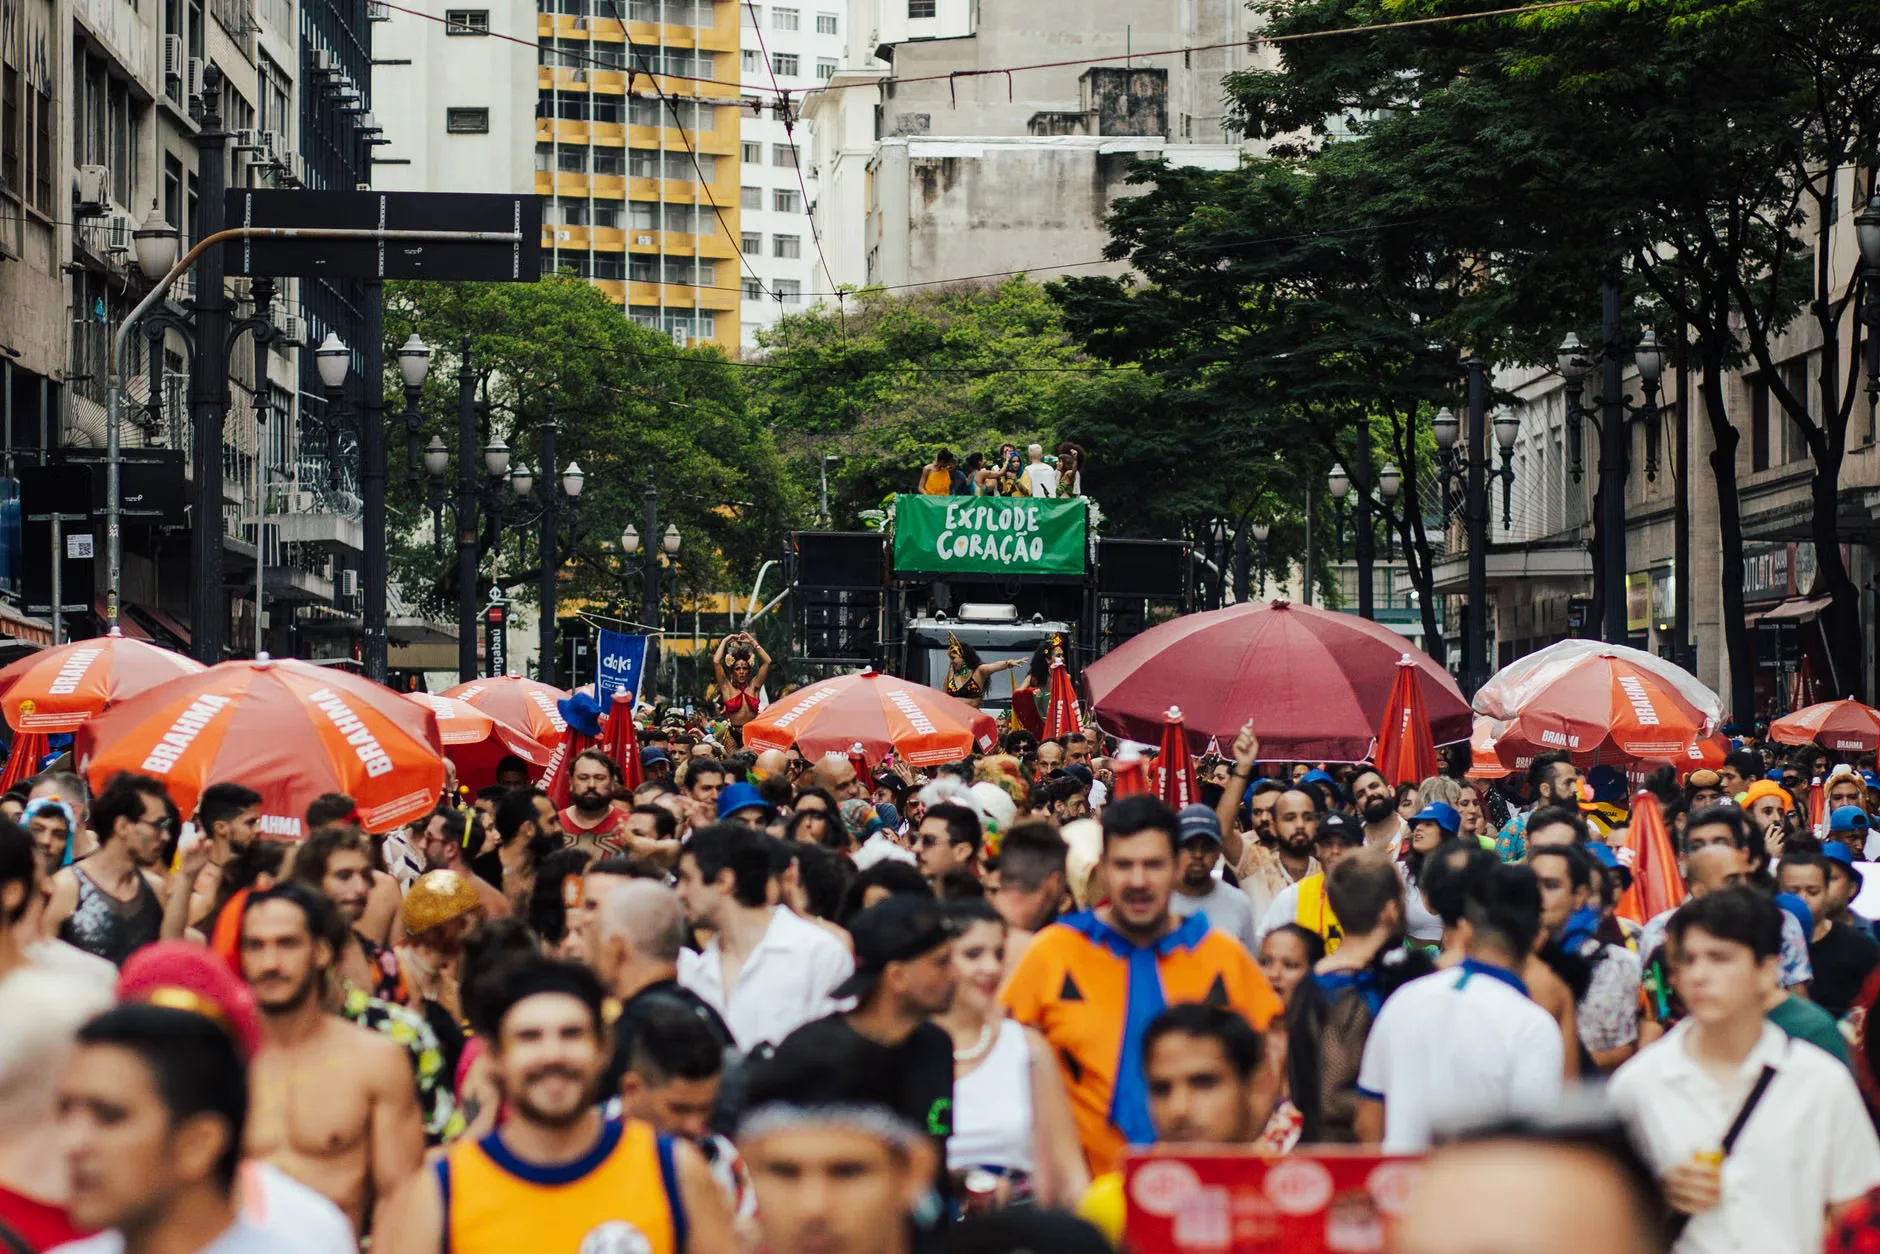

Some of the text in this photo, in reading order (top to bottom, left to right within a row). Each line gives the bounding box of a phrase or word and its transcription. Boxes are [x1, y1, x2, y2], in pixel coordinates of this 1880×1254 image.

[945, 503, 1040, 532] EXPLODE
[936, 530, 1044, 565] CORAÇÃO
[48, 648, 104, 694] BRAHMA
[490, 628, 504, 677] angabaú
[773, 687, 838, 728] BRAHMA
[887, 689, 938, 735] BRAHMA
[1616, 676, 1660, 725] BRAHMA
[141, 693, 232, 774] BRAHMA
[308, 687, 394, 779] BRAHMA
[1836, 739, 1863, 749] BRAHMA
[259, 813, 301, 837] AHMA
